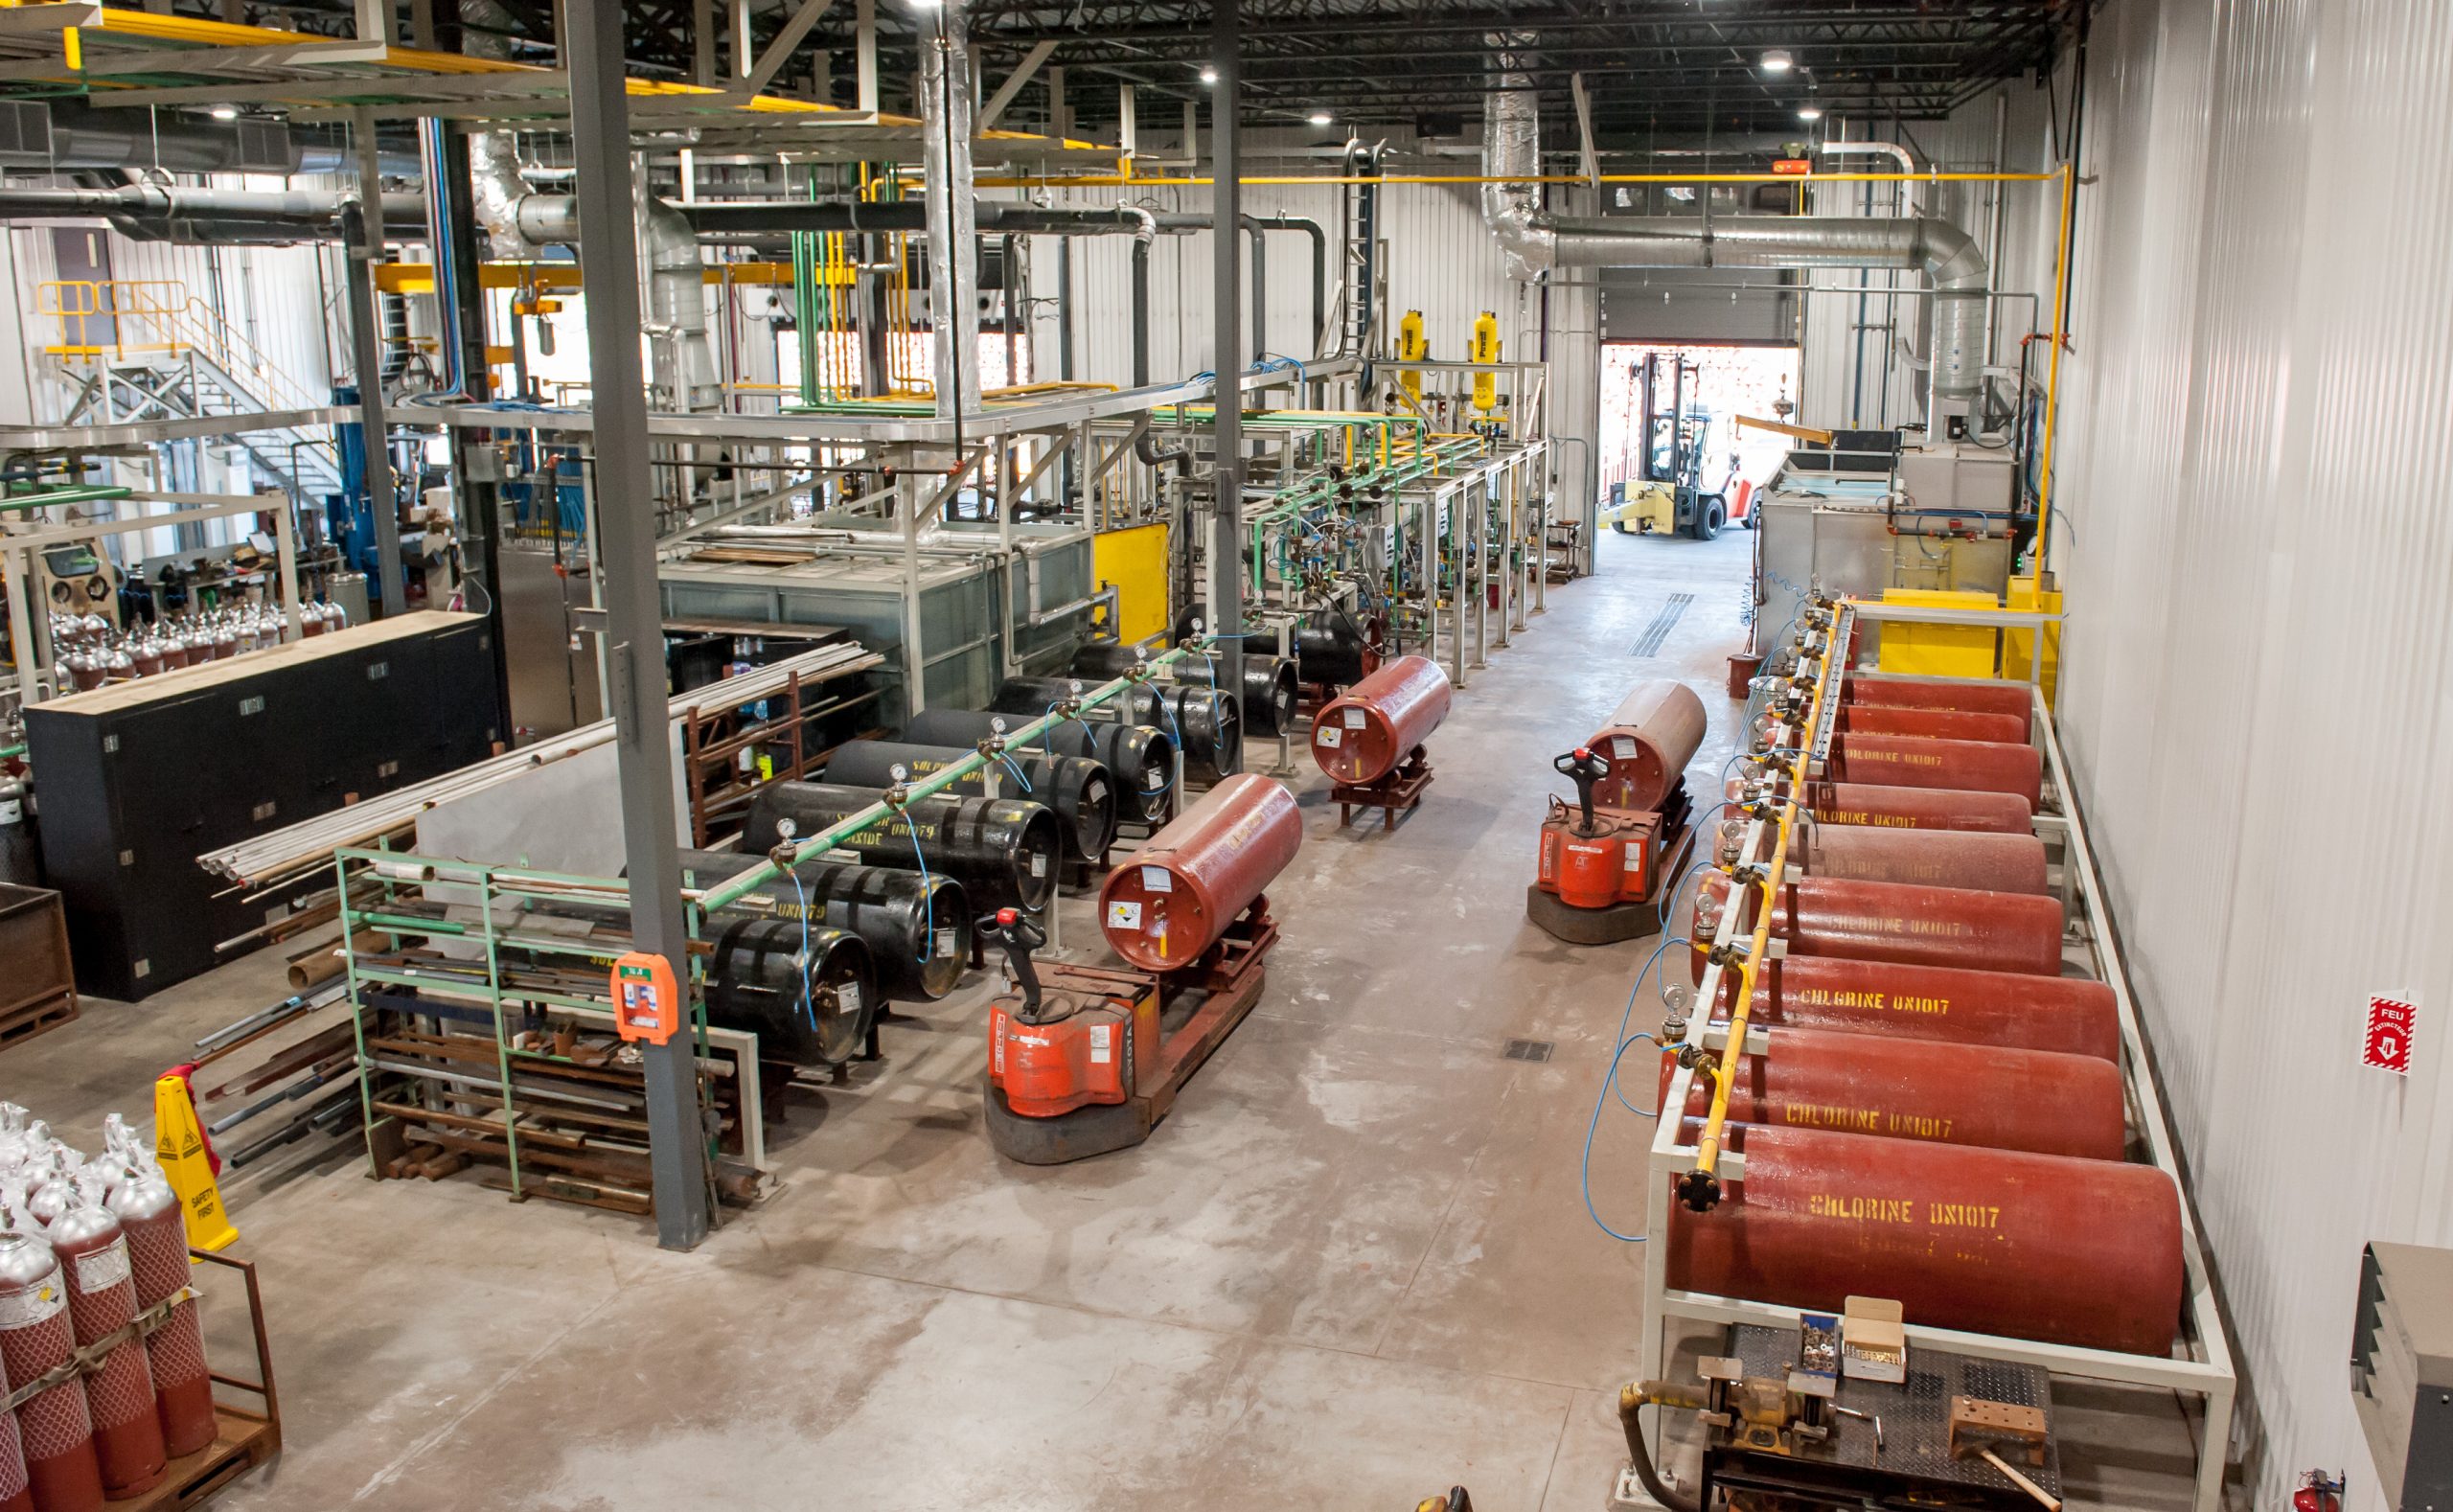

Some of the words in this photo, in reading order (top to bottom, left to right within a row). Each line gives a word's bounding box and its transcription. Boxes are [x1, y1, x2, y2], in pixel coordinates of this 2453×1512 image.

[1815, 810, 1868, 824] HLORINE
[1800, 989, 1885, 1009] CHLORINE
[1892, 996, 1950, 1015] UN1017
[2381, 1008, 2404, 1020] FEU
[1786, 1104, 1880, 1131] CHLORINE
[1890, 1113, 1953, 1138] UN1017
[192, 1186, 214, 1208] SAFETY
[197, 1202, 214, 1221] FIRST
[1810, 1195, 1914, 1224] CHLORINE
[1930, 1203, 2000, 1228] UN1017
